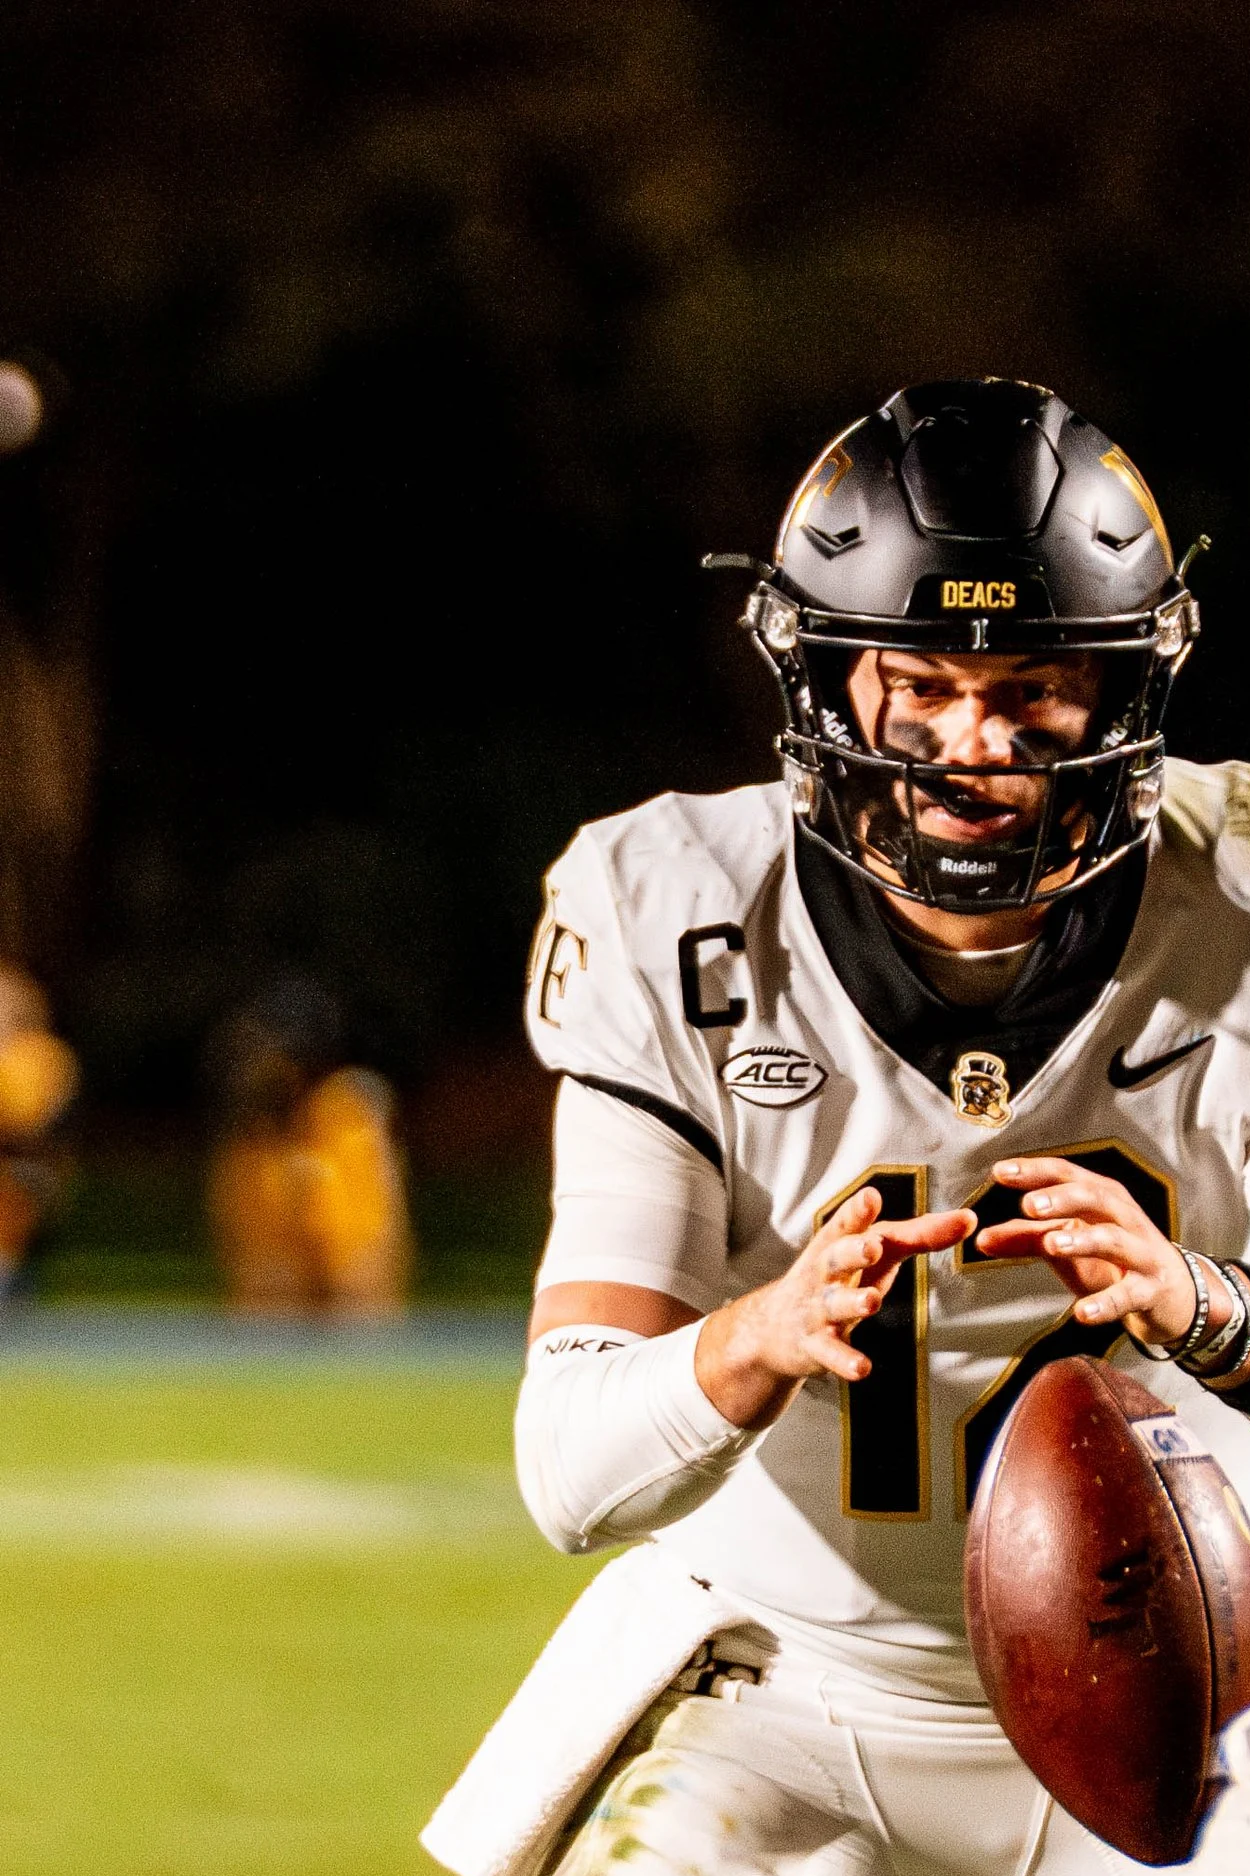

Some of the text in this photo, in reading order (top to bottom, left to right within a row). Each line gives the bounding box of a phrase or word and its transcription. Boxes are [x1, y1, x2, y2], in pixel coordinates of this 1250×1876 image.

[942, 580, 1017, 609] DEACS
[939, 856, 998, 875] Riddell
[679, 920, 748, 1029] C
[733, 1060, 811, 1084] ACC
[813, 1136, 1180, 1524] 12
